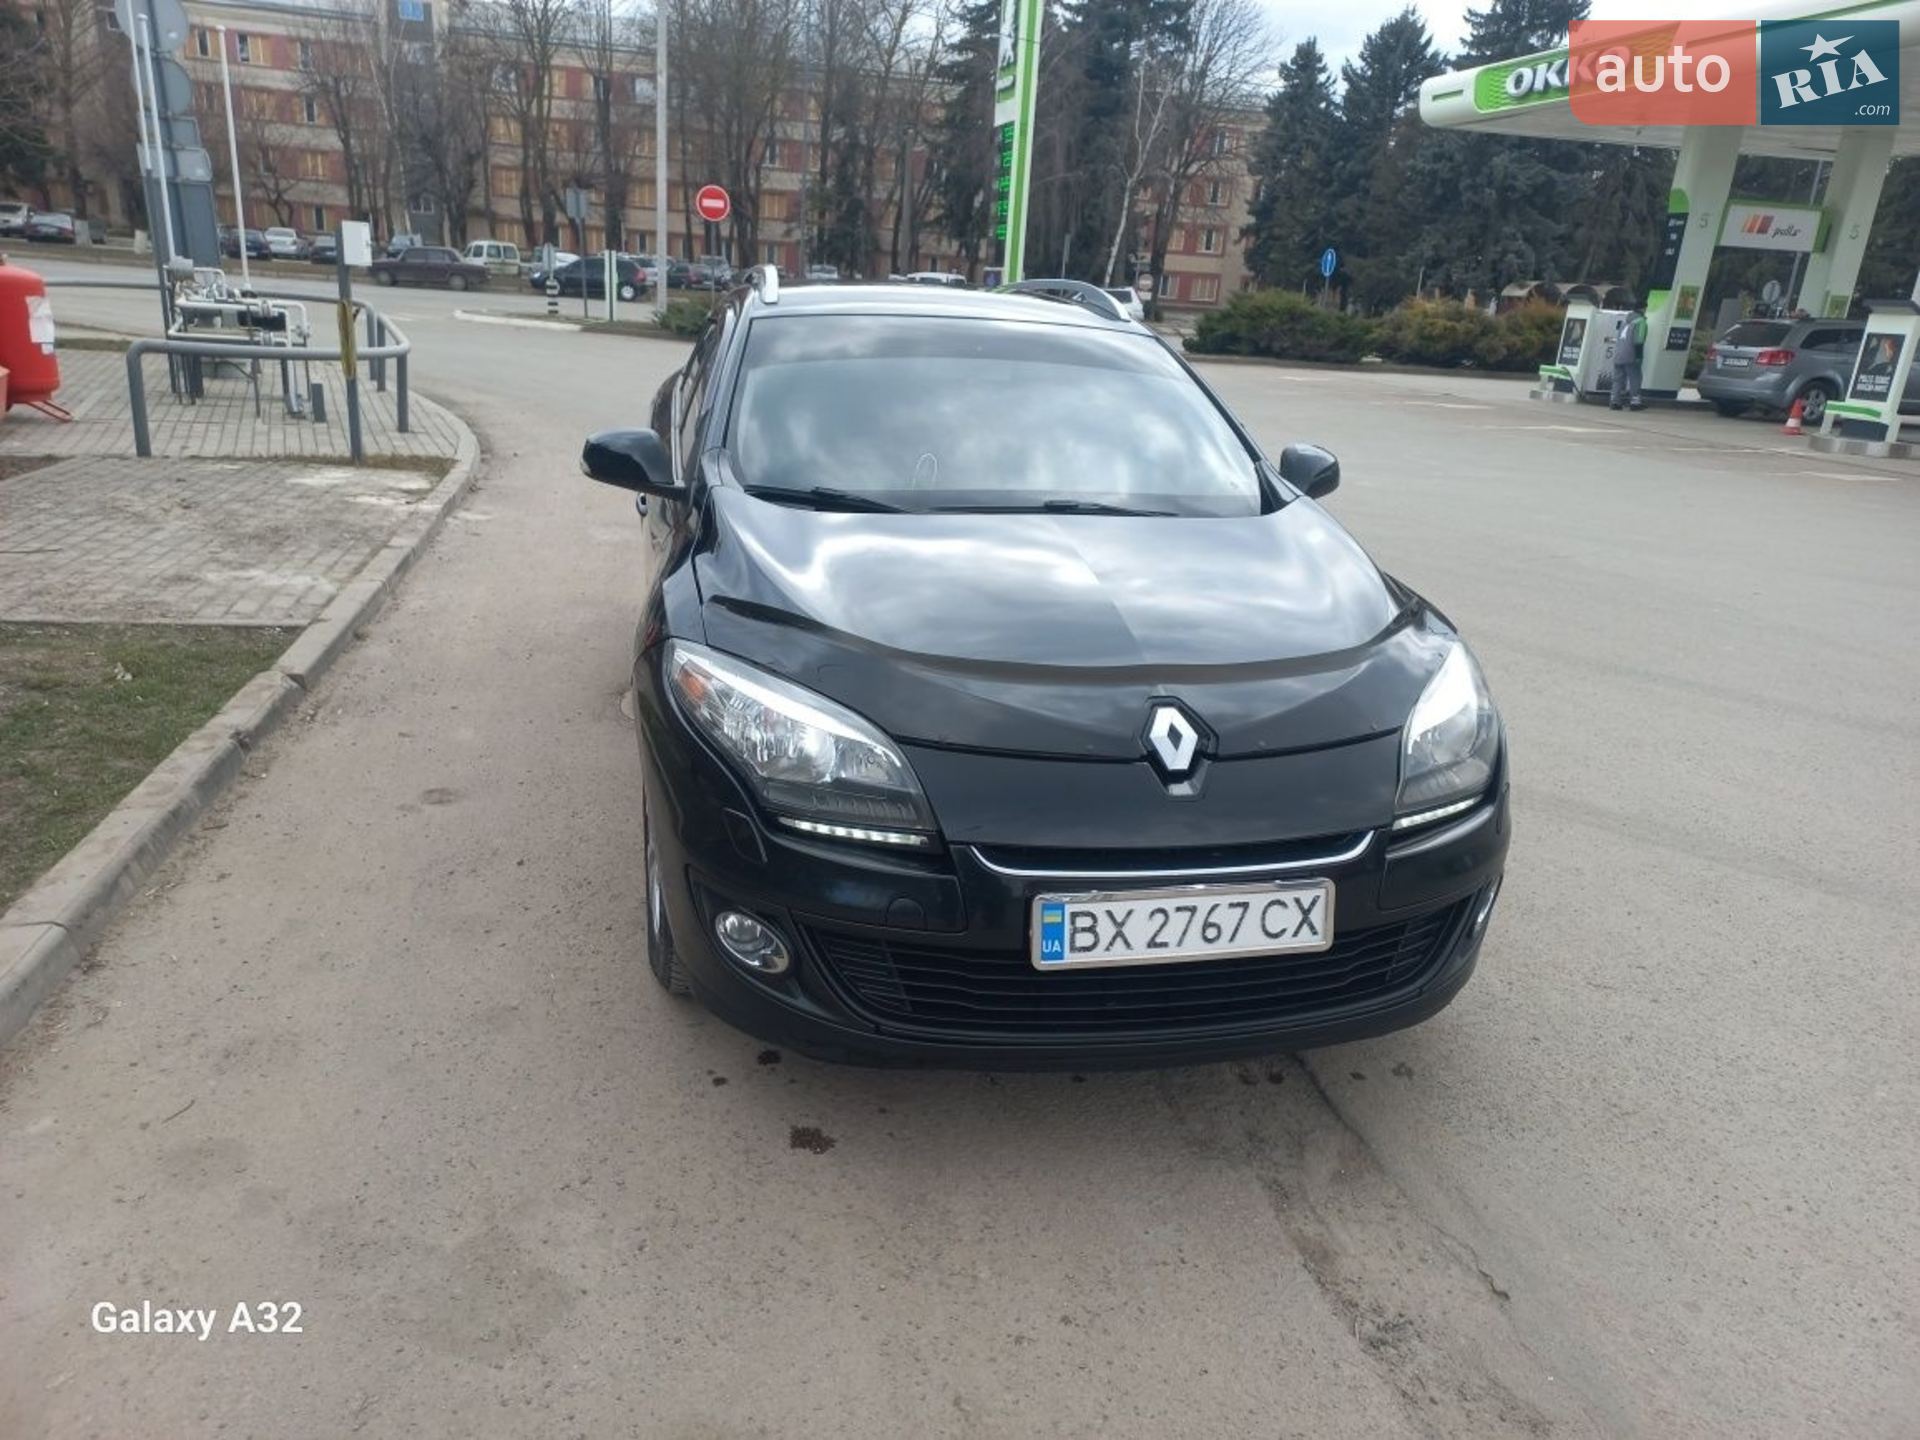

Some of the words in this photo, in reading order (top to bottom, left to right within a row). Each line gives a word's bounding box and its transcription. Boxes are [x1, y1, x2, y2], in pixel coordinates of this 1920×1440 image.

[1068, 908, 1134, 955] BX
[1145, 901, 1250, 950] 2767
[1260, 894, 1321, 940] CX
[1042, 938, 1062, 954] UA
